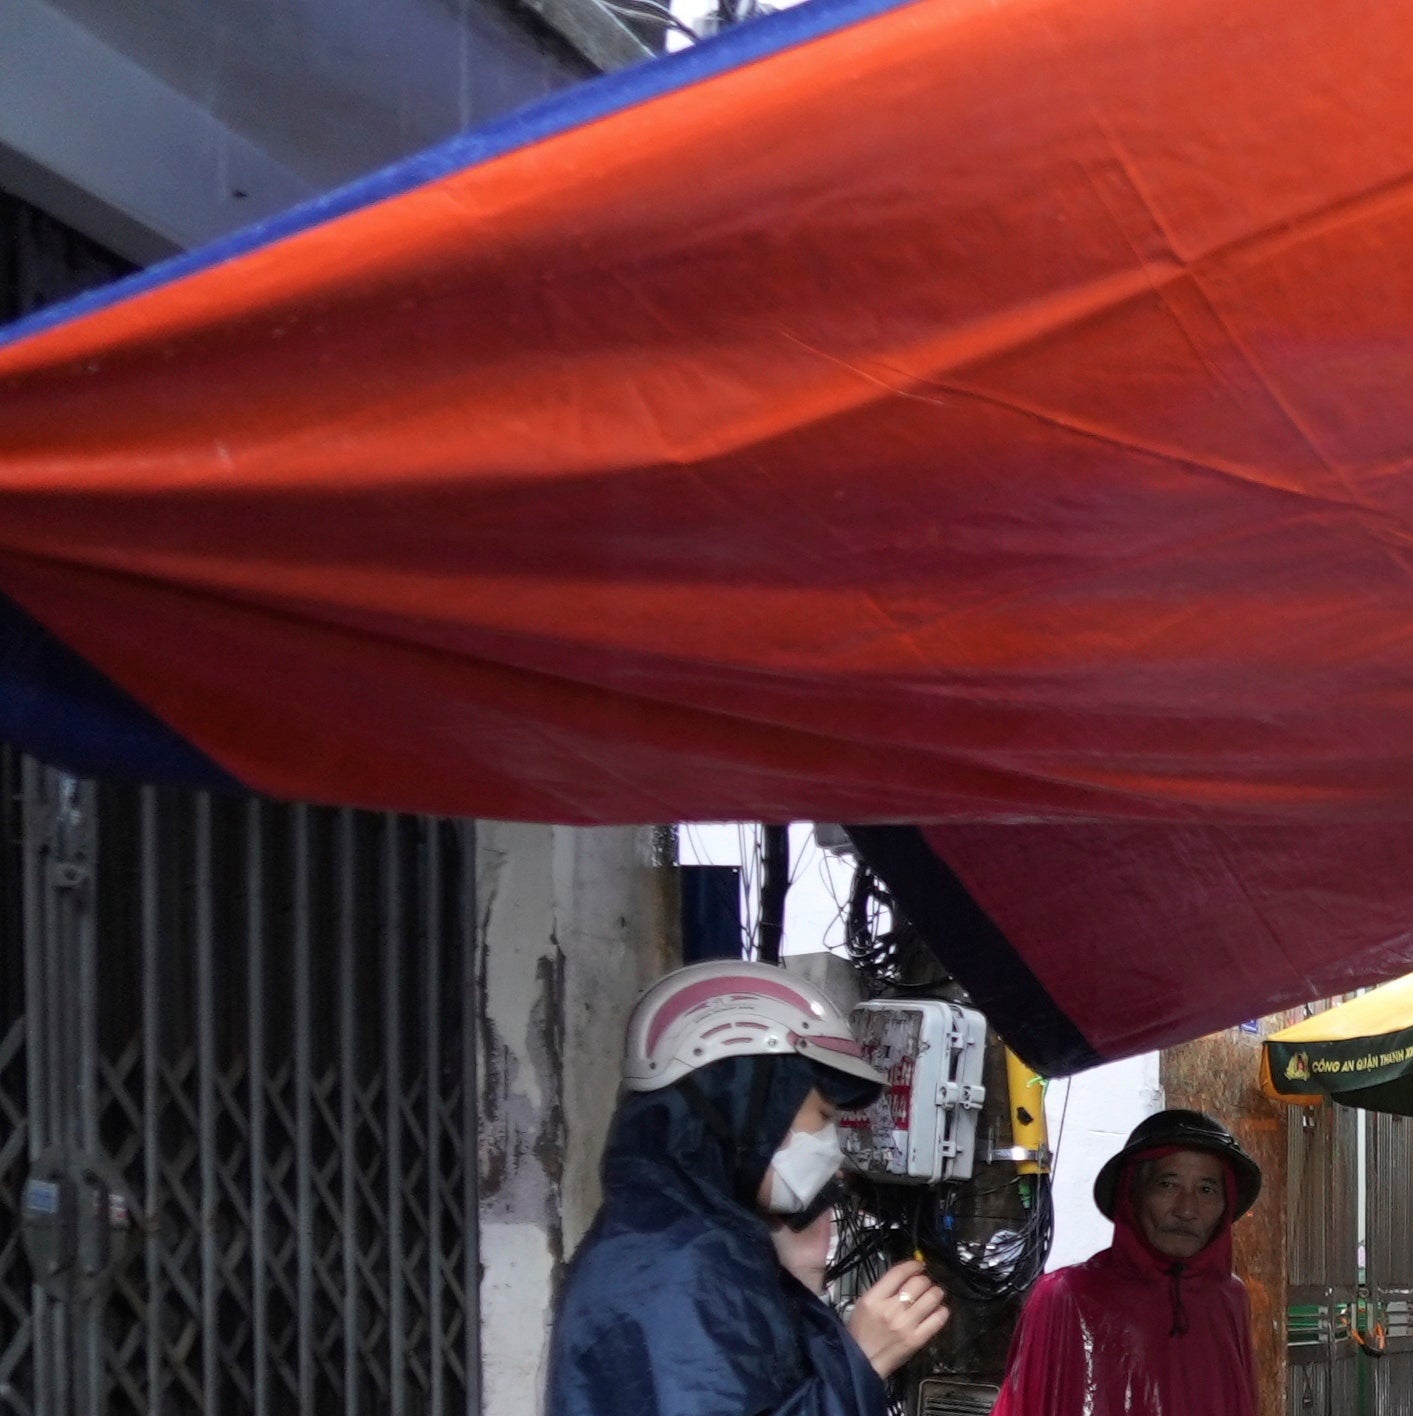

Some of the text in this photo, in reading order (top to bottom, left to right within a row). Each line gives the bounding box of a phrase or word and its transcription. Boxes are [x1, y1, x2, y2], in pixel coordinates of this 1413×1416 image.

[1312, 1058, 1340, 1073] CÔNG
[1341, 1060, 1354, 1072] AN
[1380, 1049, 1404, 1068] THANH
